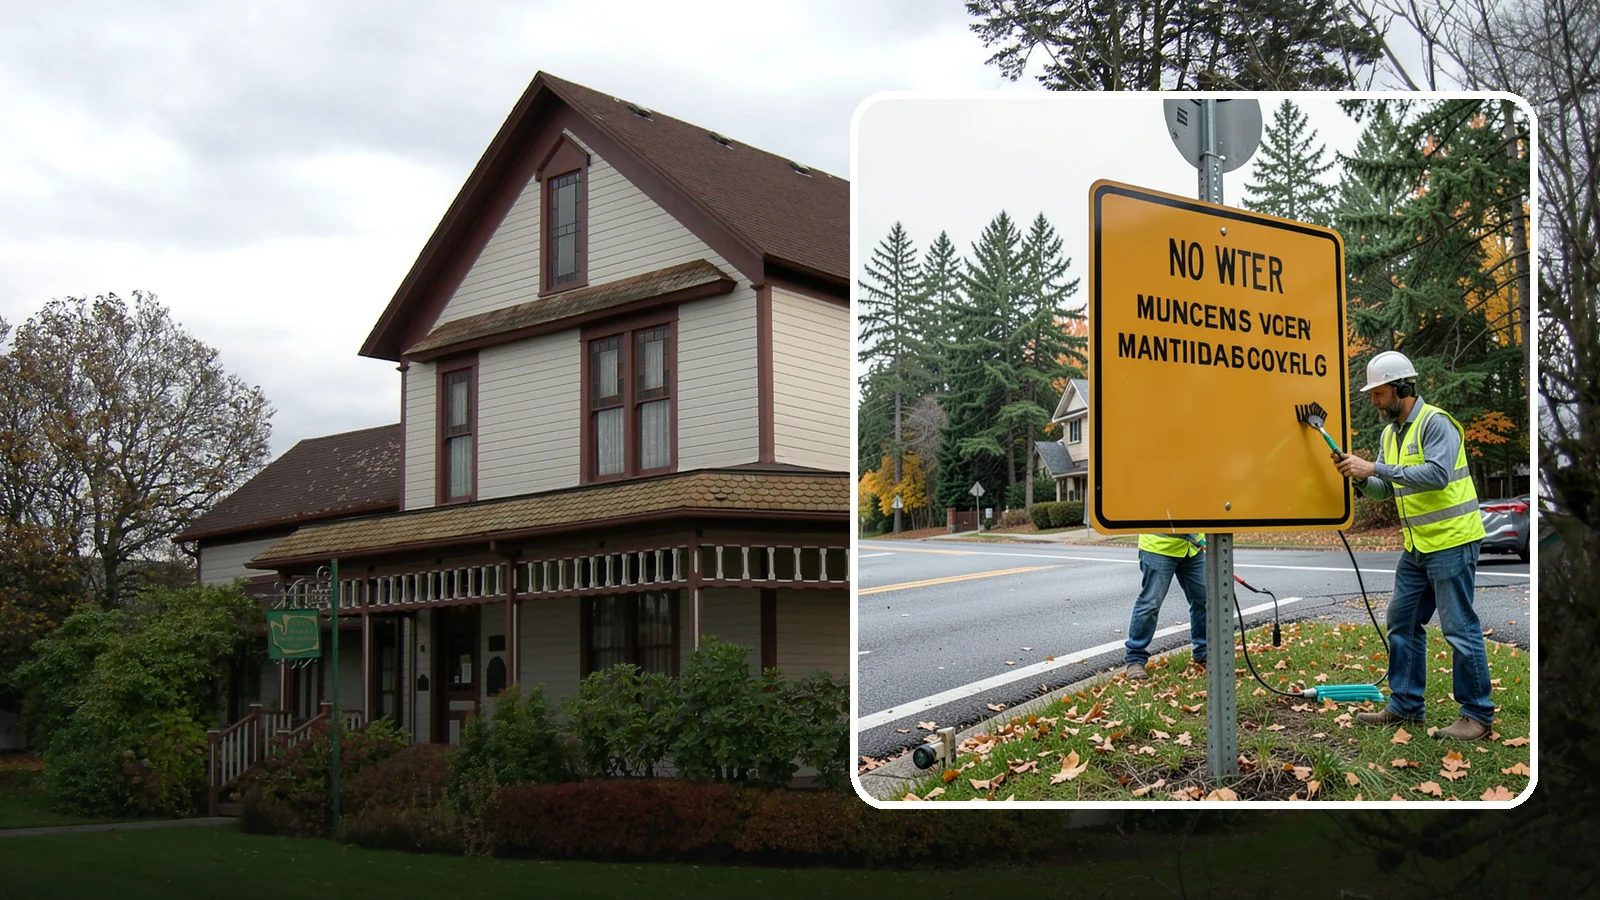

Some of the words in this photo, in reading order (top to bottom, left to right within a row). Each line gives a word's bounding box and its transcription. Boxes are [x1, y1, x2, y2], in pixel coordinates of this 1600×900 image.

[1169, 238, 1204, 281] NO
[1215, 245, 1284, 294] WTER
[1137, 294, 1252, 333] MUNCENS
